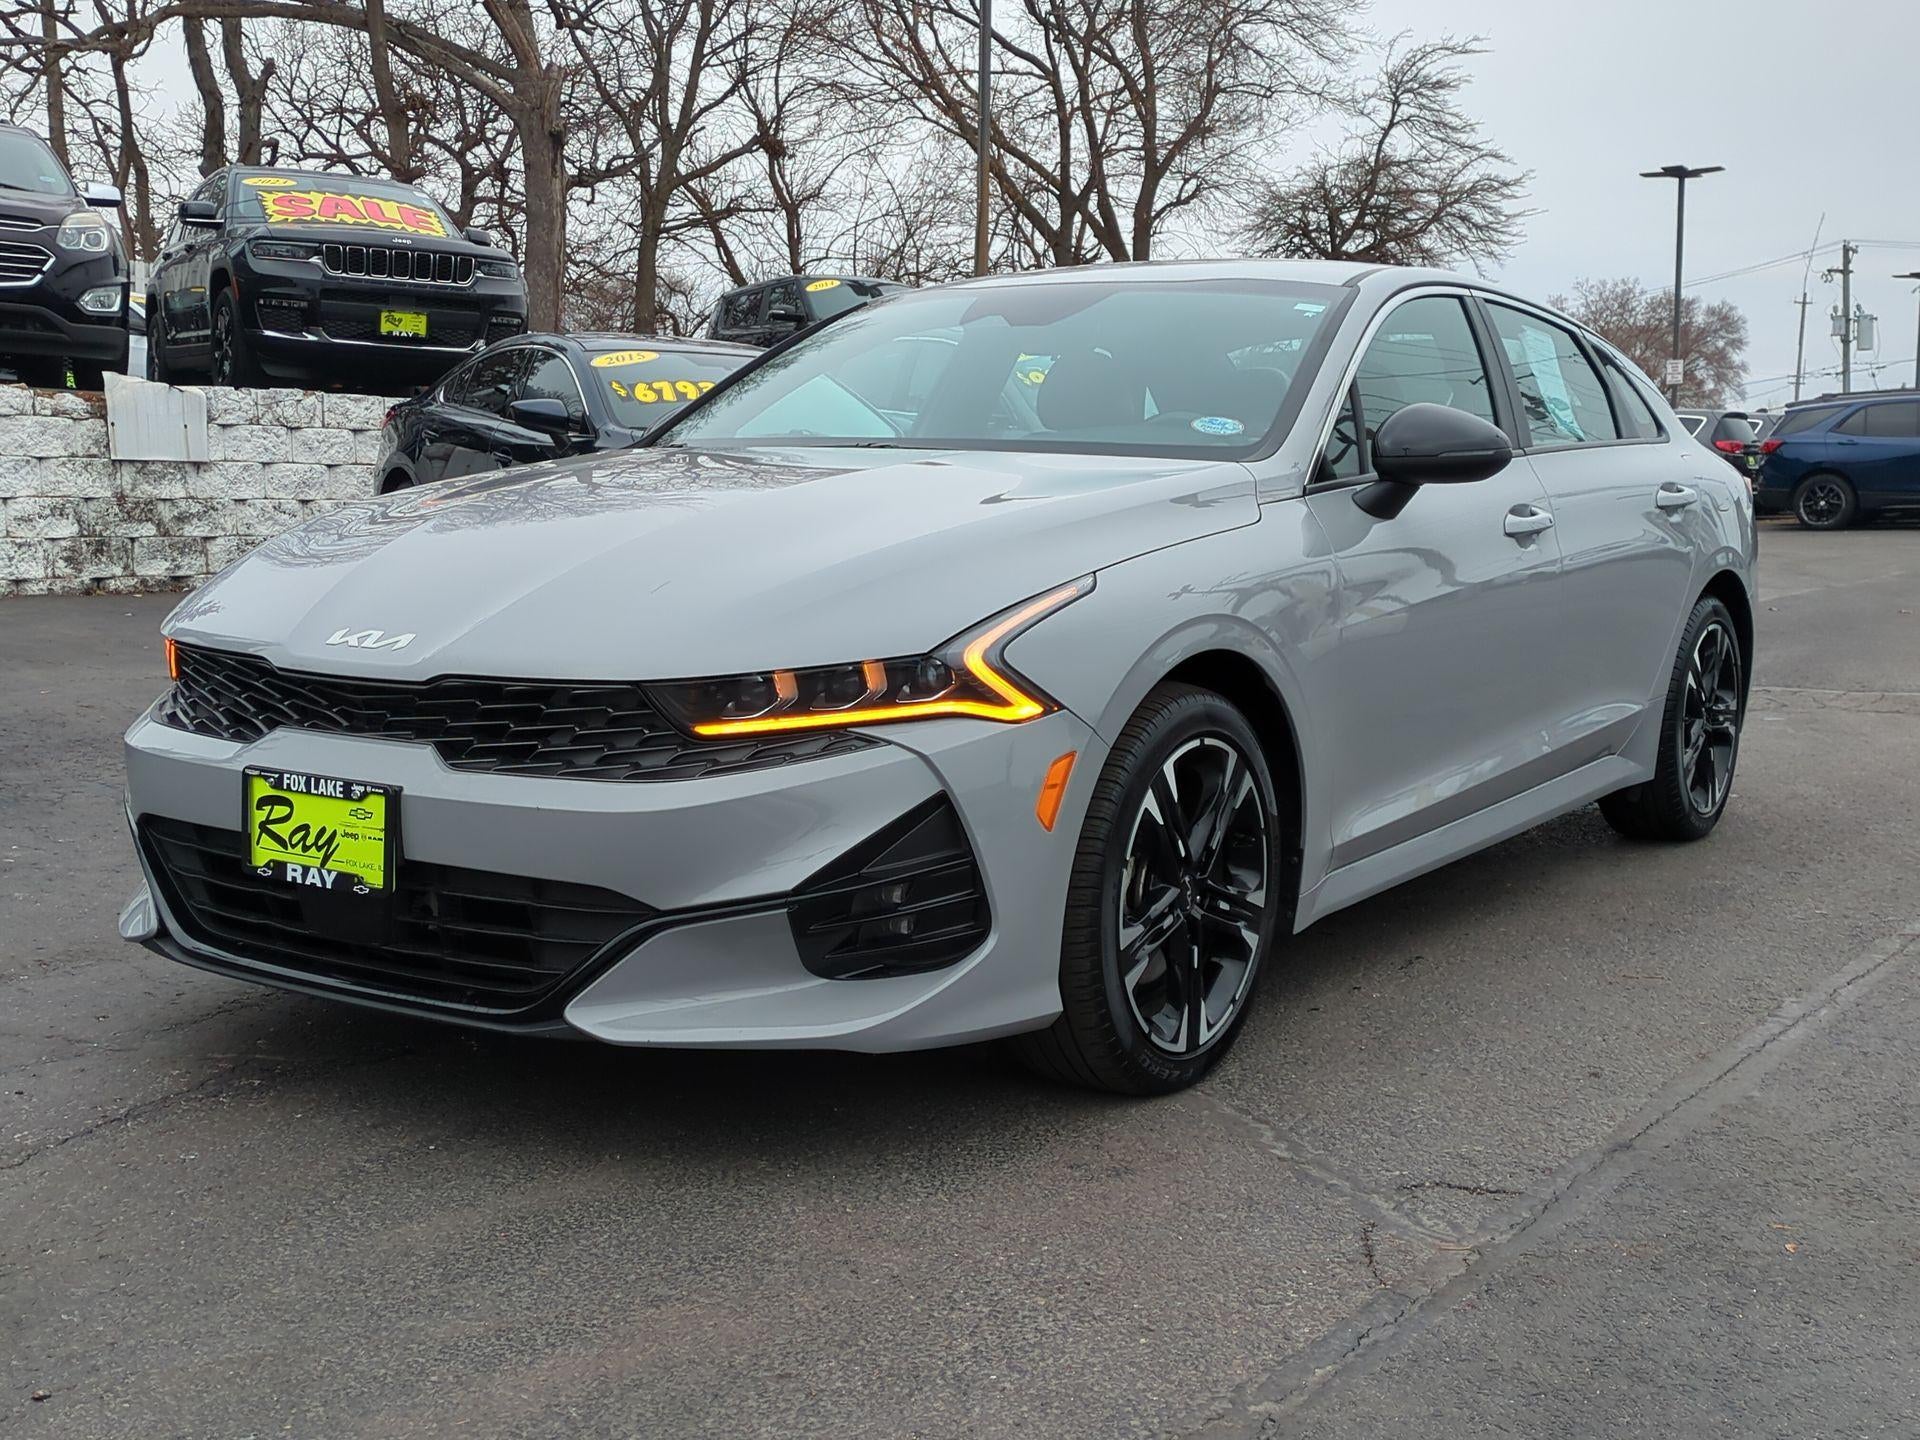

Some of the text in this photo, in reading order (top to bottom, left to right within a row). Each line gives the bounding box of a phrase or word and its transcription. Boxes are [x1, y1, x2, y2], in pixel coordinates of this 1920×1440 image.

[272, 195, 436, 232] SALE
[392, 237, 412, 245] Jeep
[604, 352, 646, 365] 2015
[283, 773, 308, 793] FOX
[311, 776, 344, 798] LAKE
[256, 794, 340, 868] Ray
[340, 829, 359, 841] Jeep
[345, 859, 358, 868] FOX
[286, 863, 338, 889] RAY
